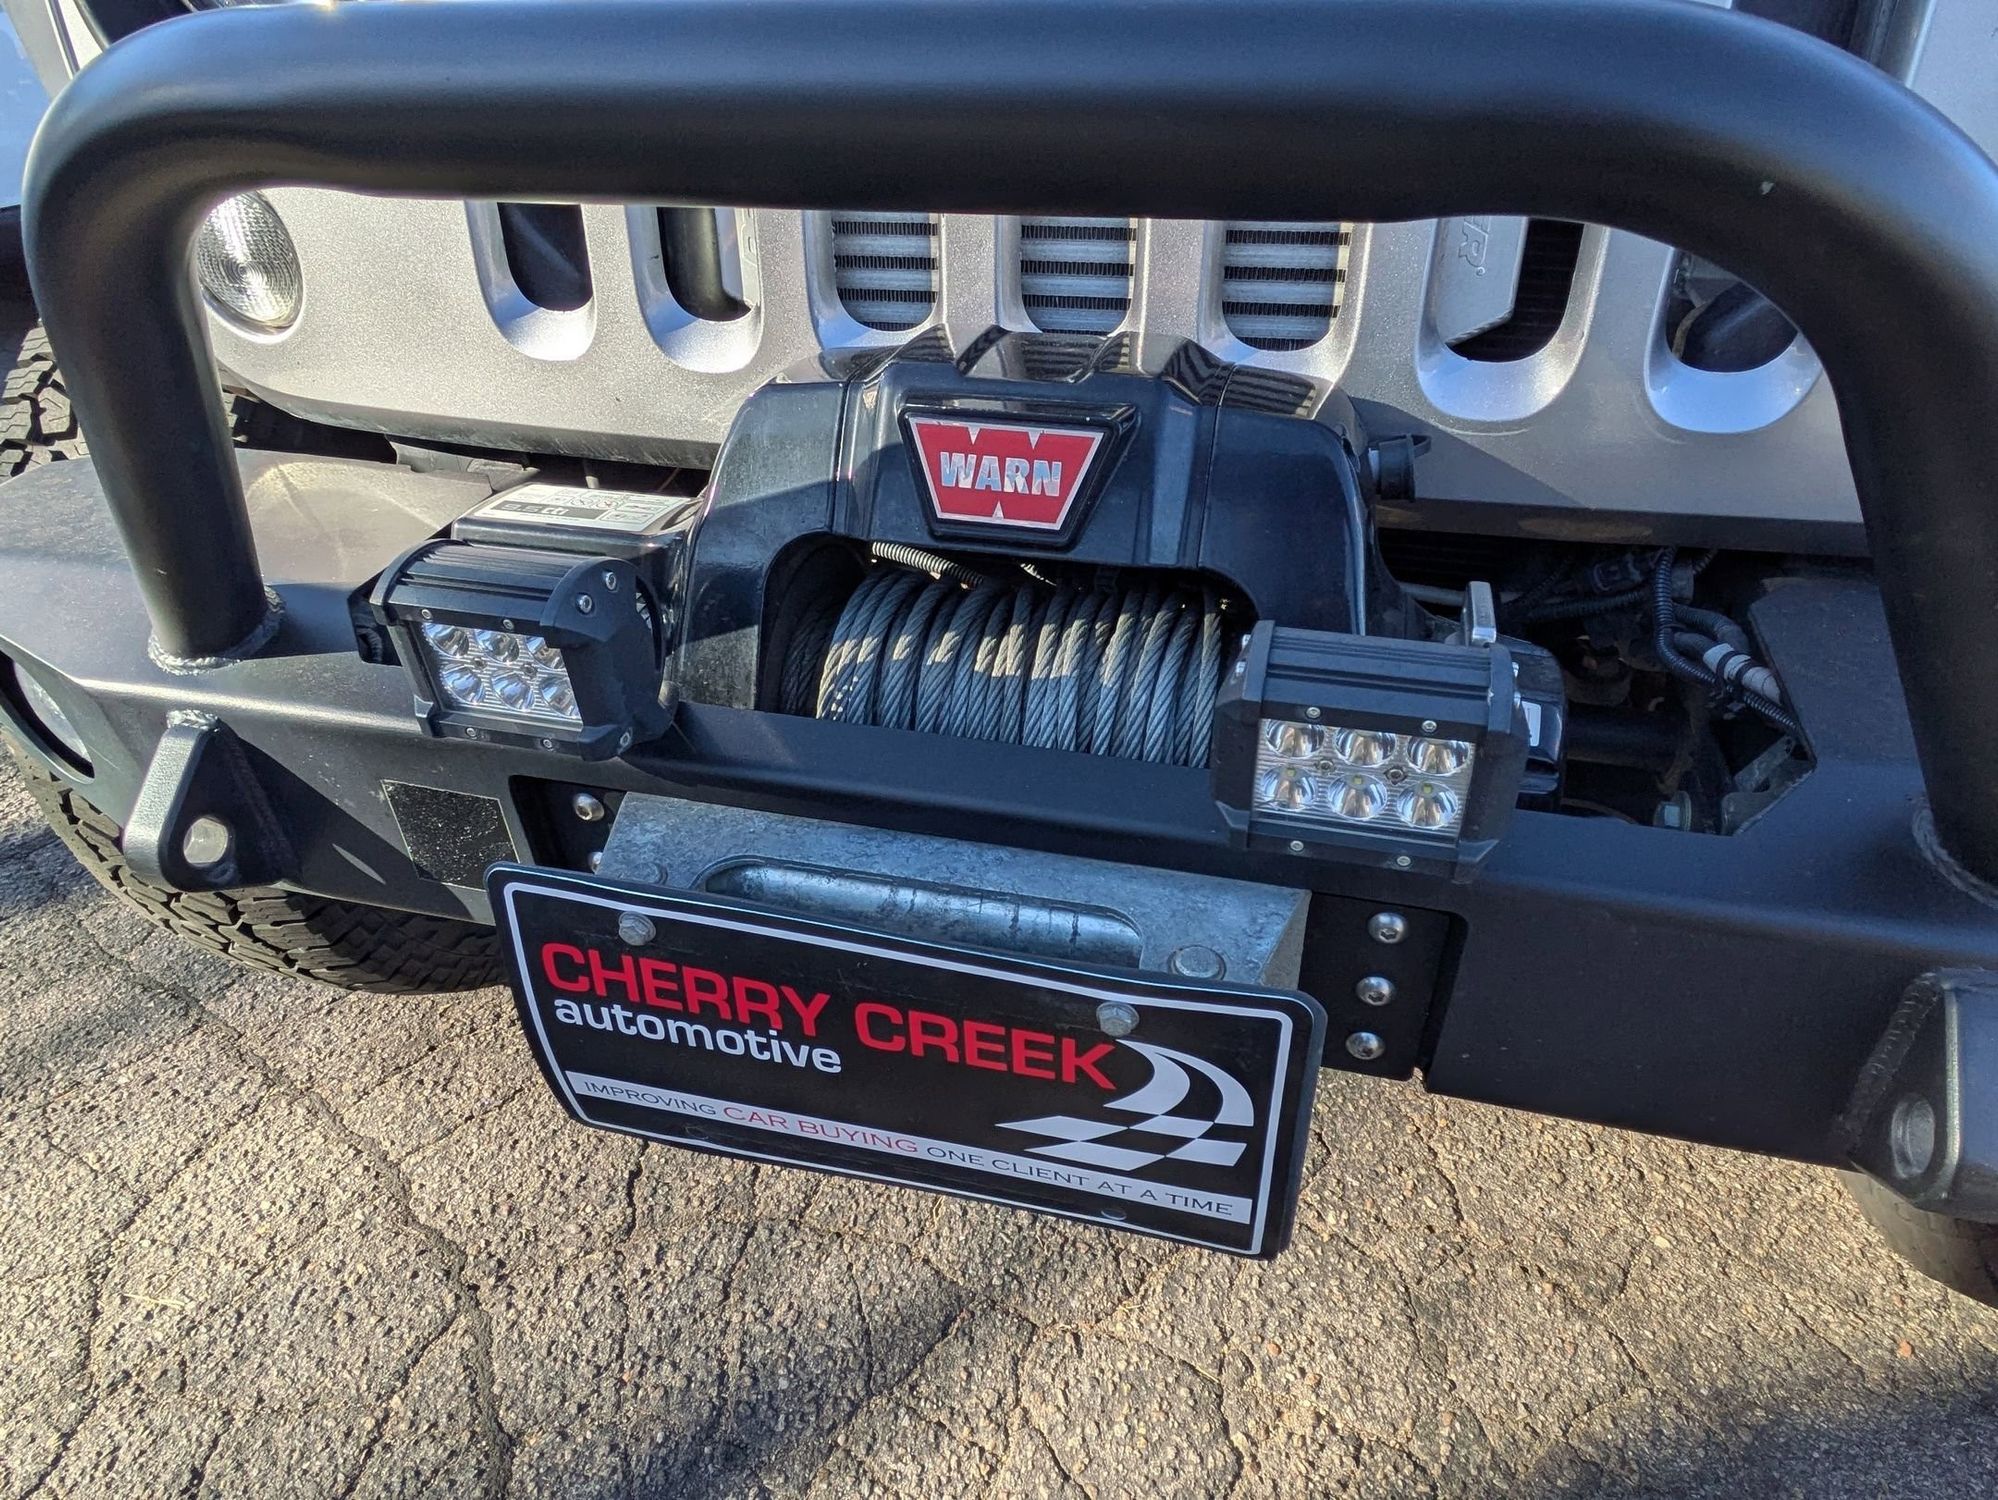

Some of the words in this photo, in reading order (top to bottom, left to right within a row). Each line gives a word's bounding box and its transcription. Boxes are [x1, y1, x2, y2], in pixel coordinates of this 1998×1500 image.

[939, 451, 1063, 497] WARN
[541, 943, 831, 1037] CHERRY
[854, 1002, 1117, 1090] CREEK
[553, 997, 843, 1074] automotive
[584, 1081, 717, 1116] IMPROVING
[722, 1106, 789, 1129] CAR
[798, 1120, 919, 1153] BUYING
[926, 1146, 985, 1166] ONE
[991, 1159, 1090, 1186] CLIENT
[1097, 1180, 1133, 1195] AT
[1140, 1189, 1158, 1202] A
[1164, 1192, 1233, 1216] TIME
